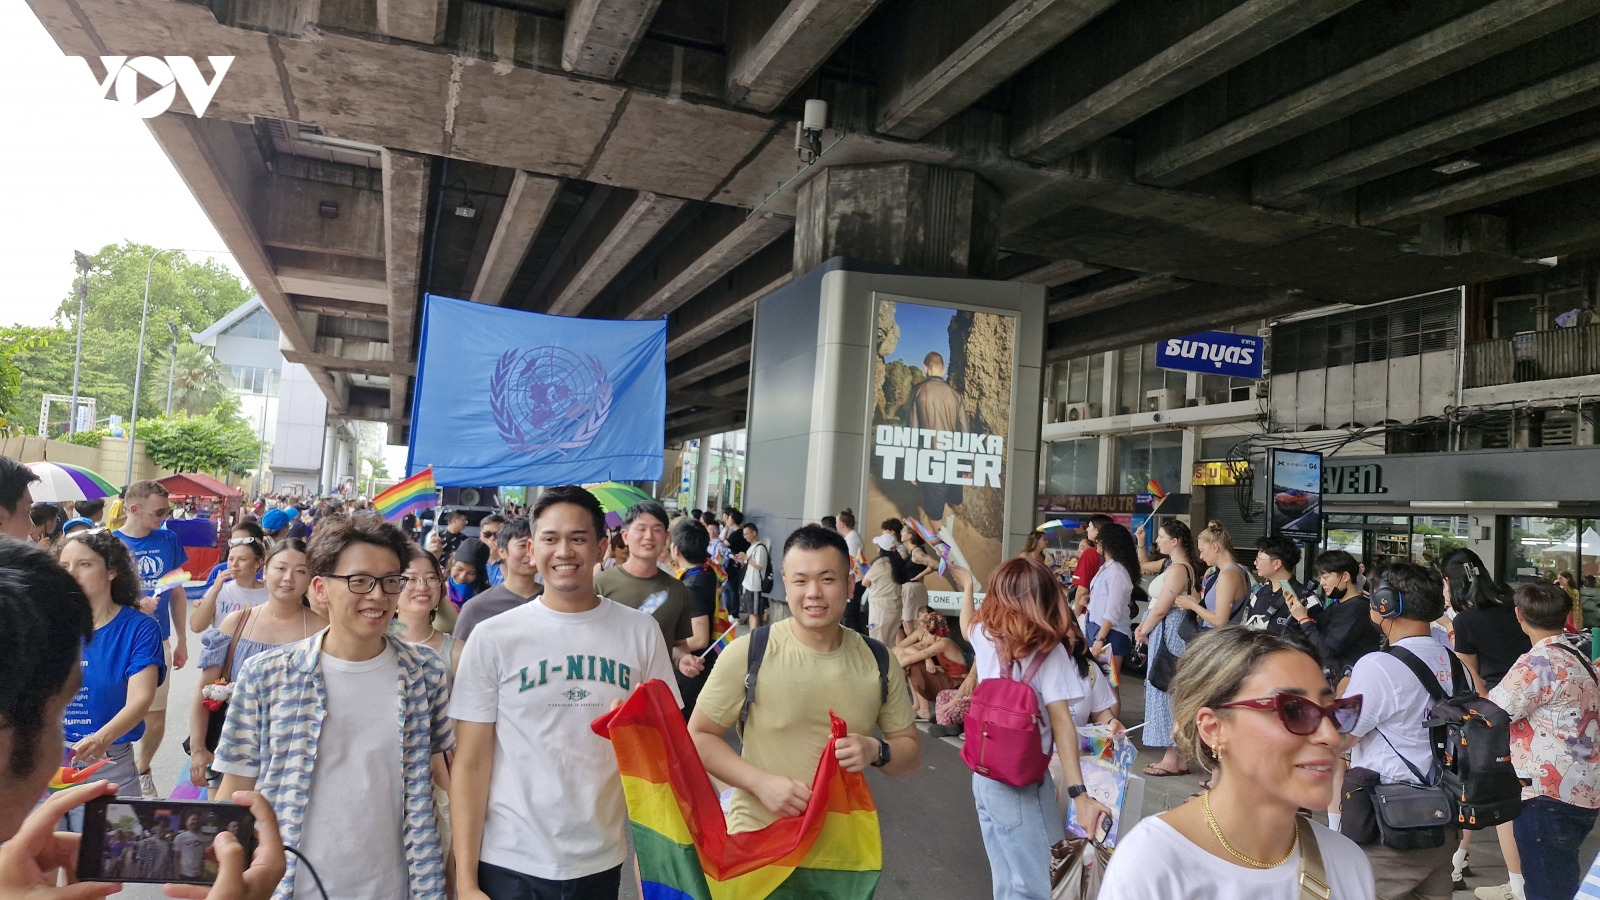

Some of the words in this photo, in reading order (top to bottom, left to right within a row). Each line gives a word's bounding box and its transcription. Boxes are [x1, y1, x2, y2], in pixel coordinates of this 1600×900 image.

[1165, 338, 1255, 368] ธนาบุตร
[876, 424, 1004, 455] ONITSUKA
[875, 446, 1002, 489] TIGER
[1308, 462, 1318, 470] G6
[518, 654, 631, 693] LI-NING
